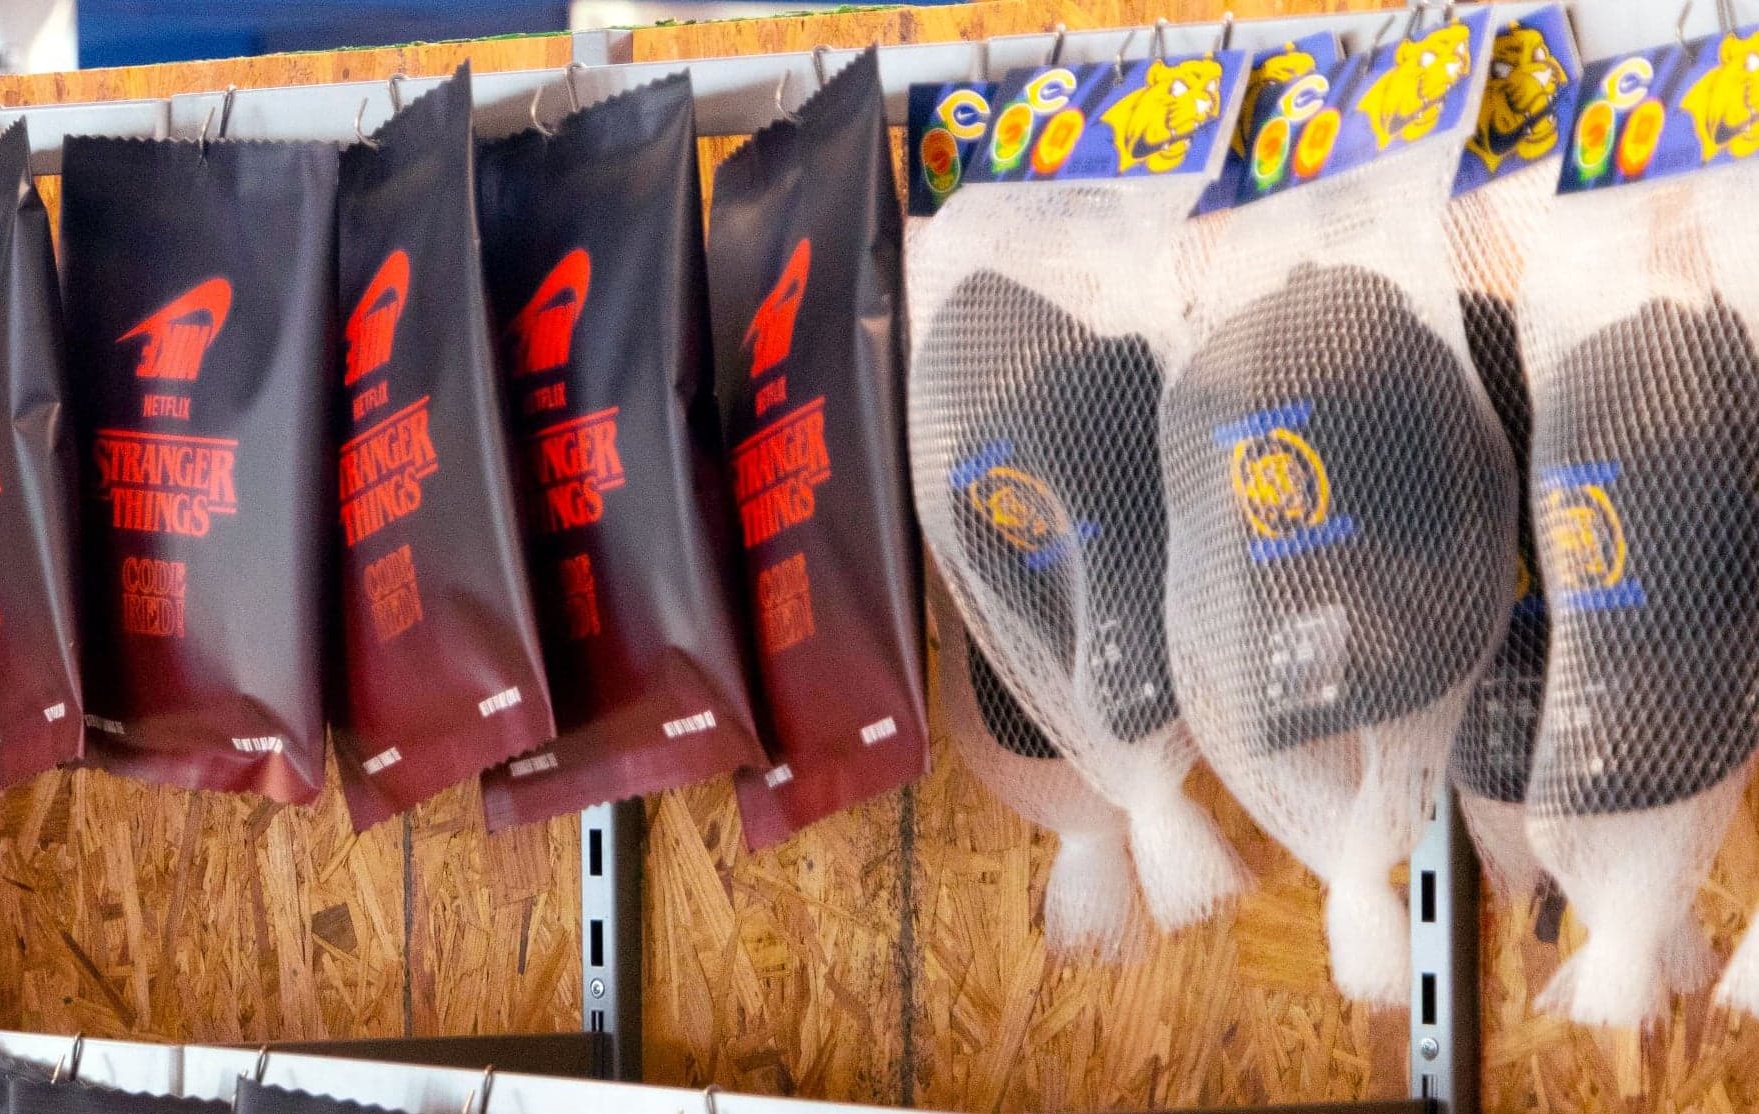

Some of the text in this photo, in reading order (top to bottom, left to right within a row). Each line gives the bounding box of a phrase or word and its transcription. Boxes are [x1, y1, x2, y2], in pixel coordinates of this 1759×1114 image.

[143, 395, 190, 420] NETFLIX
[97, 437, 237, 503] STRANGER
[111, 490, 211, 537] THINGS
